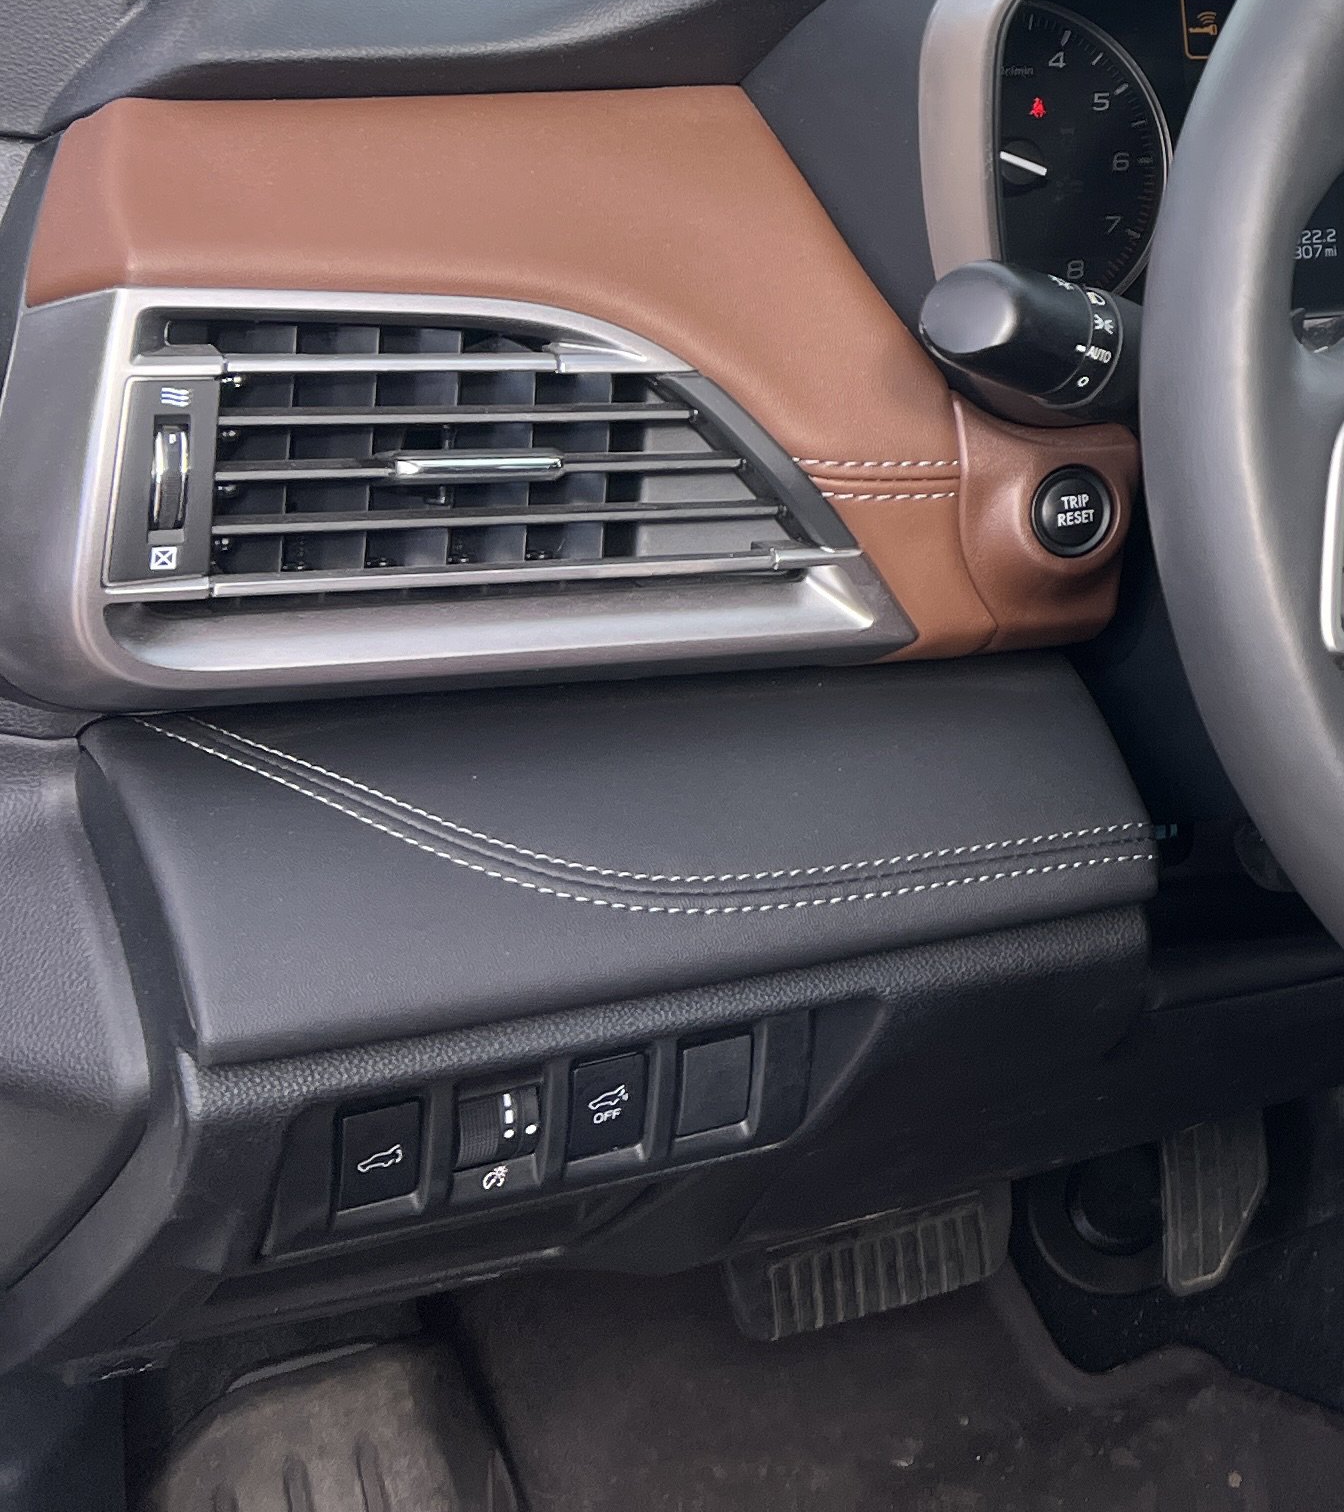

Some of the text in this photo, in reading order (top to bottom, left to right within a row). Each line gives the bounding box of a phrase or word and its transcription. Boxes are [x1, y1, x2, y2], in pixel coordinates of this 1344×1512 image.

[1048, 52, 1066, 68] 4
[1092, 92, 1110, 111] 5
[1112, 152, 1130, 171] 6
[1105, 216, 1121, 234] 7
[1325, 244, 1338, 257] mi
[1066, 260, 1084, 281] 8
[1088, 345, 1112, 364] AUTO
[1060, 493, 1089, 509] TRIP
[1057, 509, 1095, 527] RESET
[593, 1107, 622, 1124] OFF
